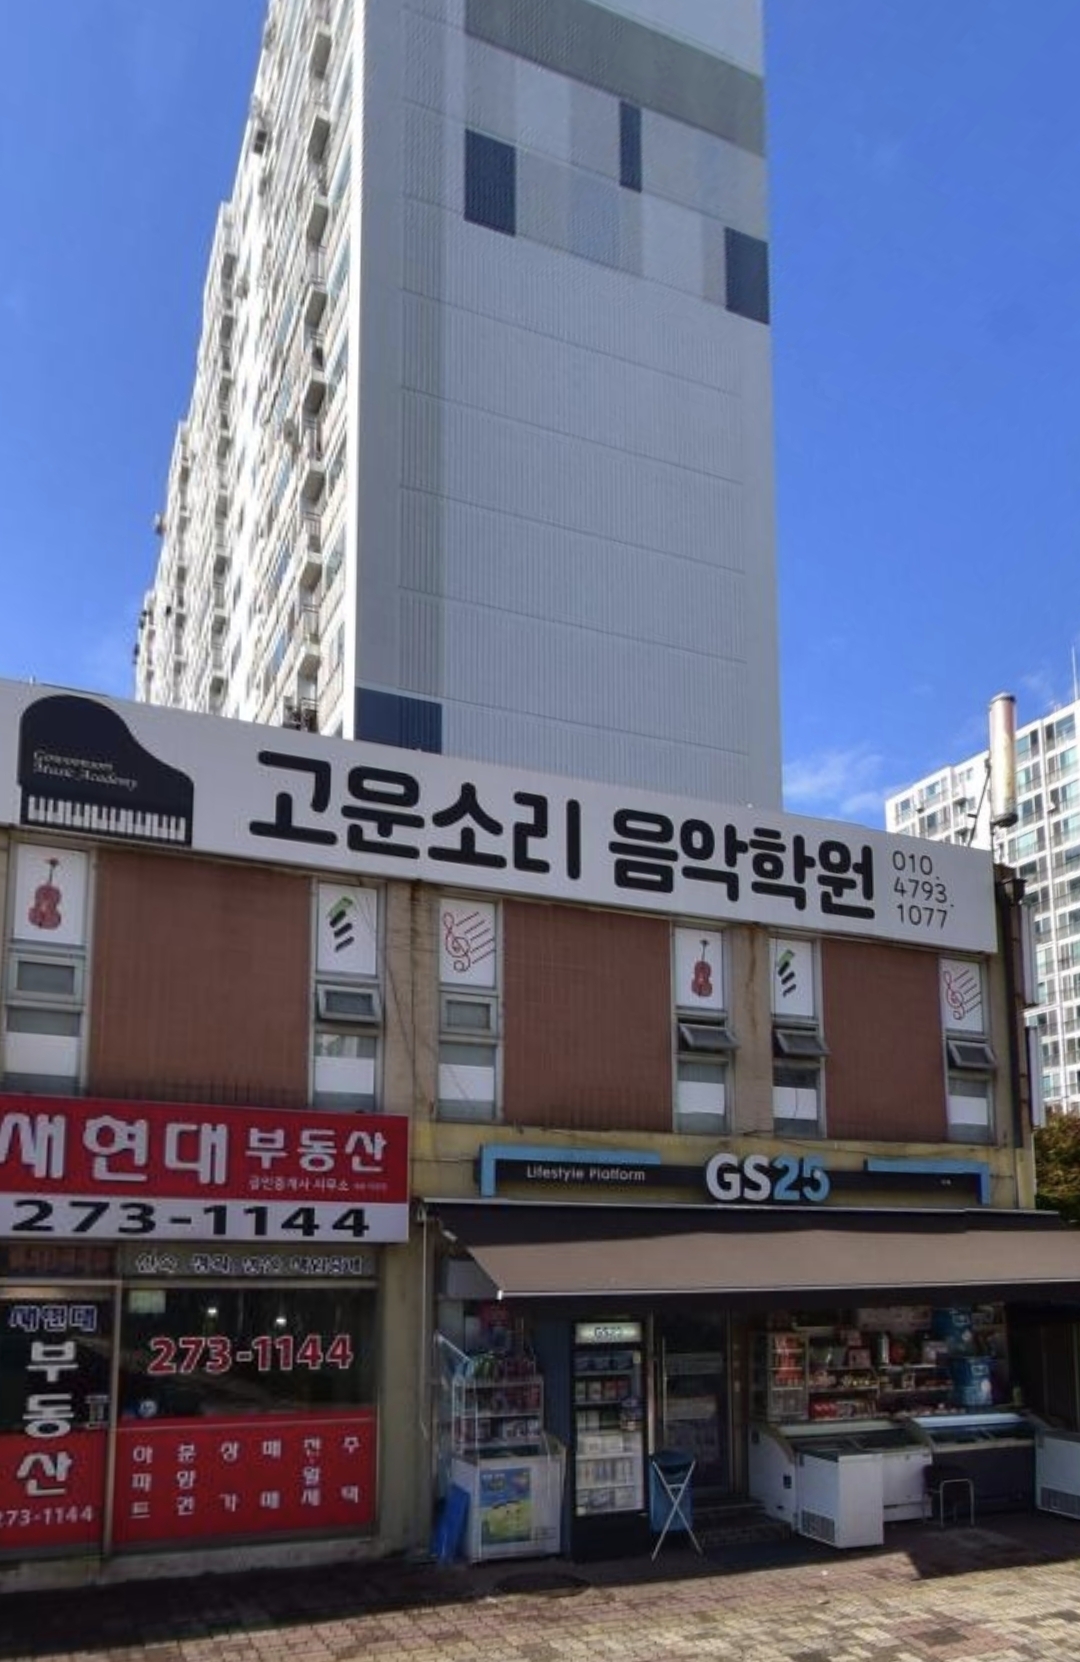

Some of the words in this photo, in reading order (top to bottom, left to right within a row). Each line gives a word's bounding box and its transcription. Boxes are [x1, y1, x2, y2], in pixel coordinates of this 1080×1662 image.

[249, 750, 581, 881] 고운소리
[608, 807, 876, 921] 음악학원
[891, 849, 941, 881] 010.
[893, 878, 956, 909] 4793.
[896, 903, 949, 930] 1077
[245, 1127, 387, 1172] 부동산
[526, 1166, 585, 1182] Lifestyle
[588, 1168, 647, 1184] Platform
[705, 1152, 832, 1202] GS25
[12, 1198, 370, 1238] 273-1144
[147, 1334, 354, 1375] 273-1144
[16, 1340, 80, 1497] 부동산
